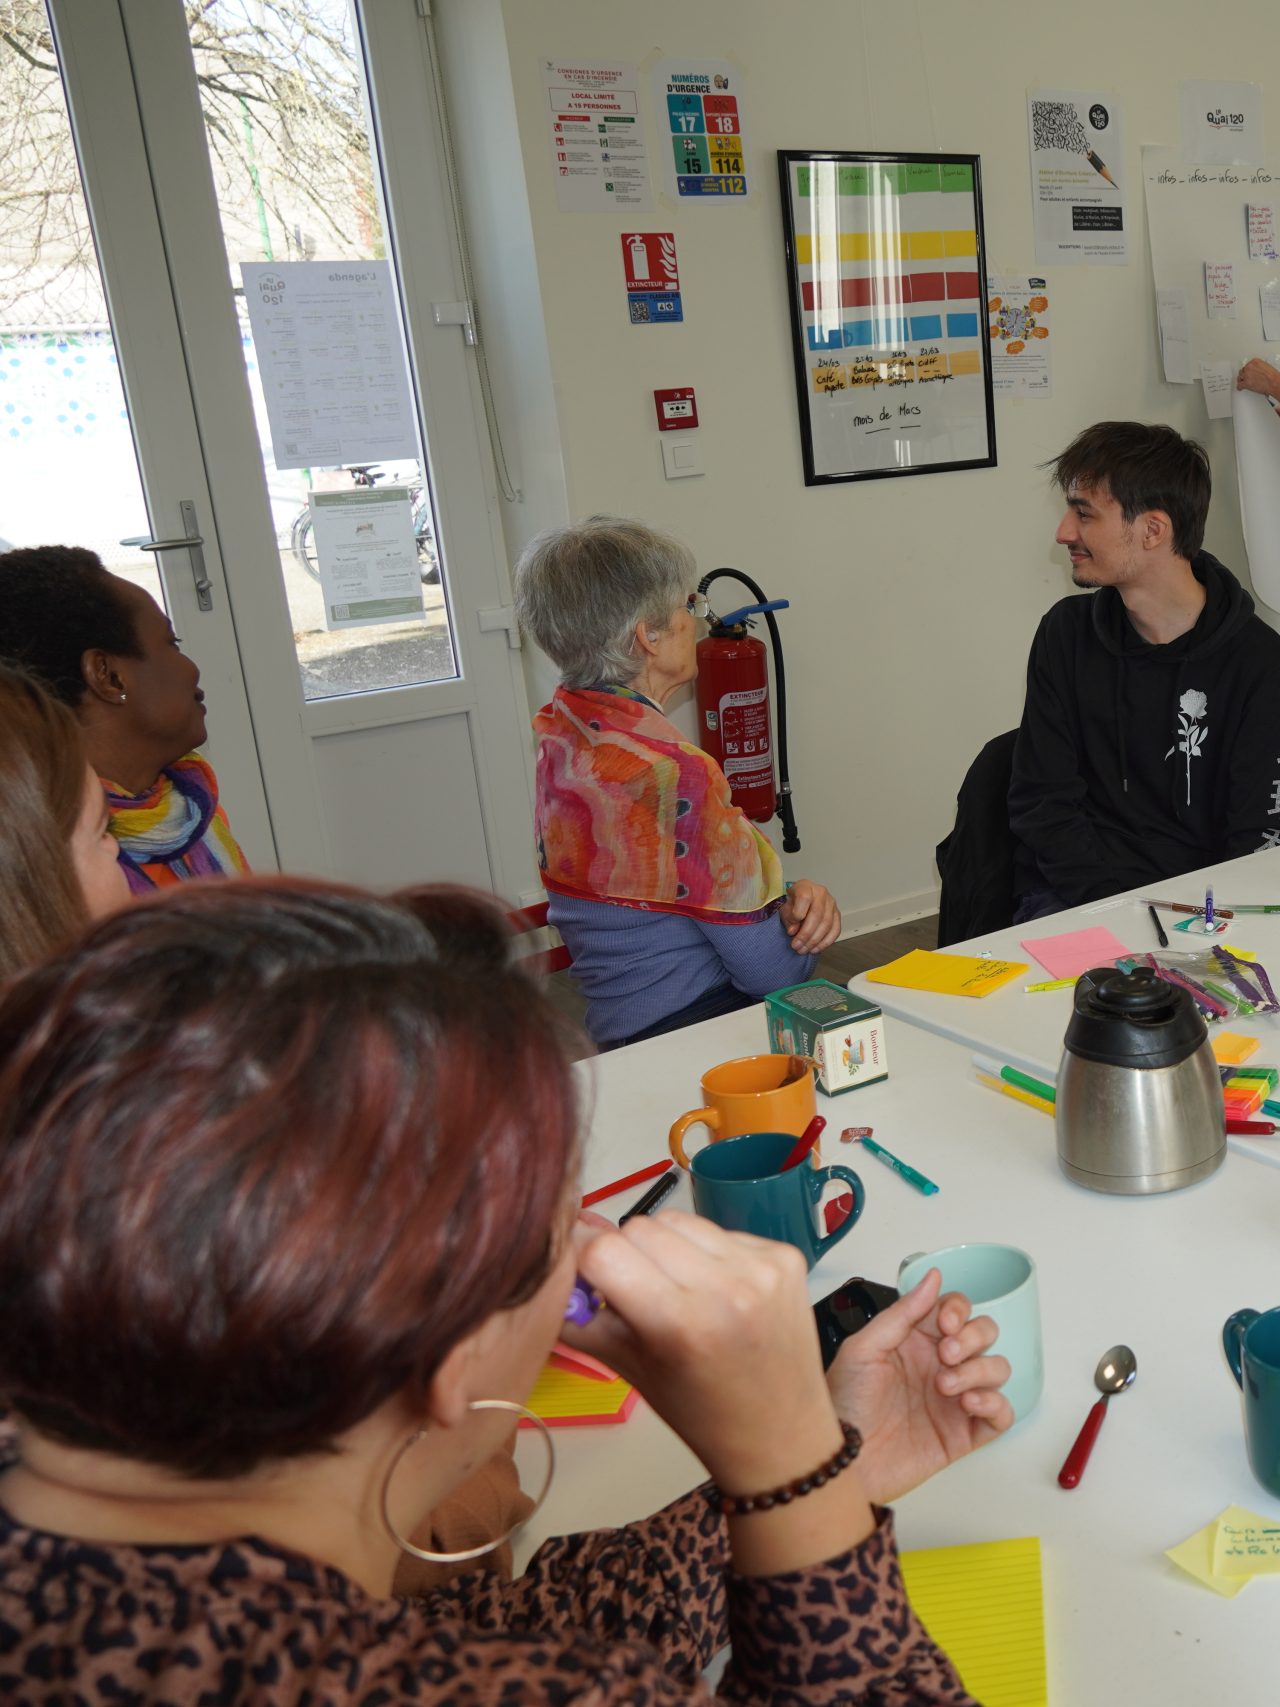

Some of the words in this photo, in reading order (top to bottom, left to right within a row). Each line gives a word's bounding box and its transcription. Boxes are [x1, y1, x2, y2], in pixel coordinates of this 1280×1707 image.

[671, 74, 710, 84] NUMÉROS
[667, 84, 712, 94] D'URGENCE
[678, 117, 697, 133] 17
[715, 117, 734, 133] 18
[1206, 112, 1229, 125] Quai
[1229, 113, 1244, 124] 120
[684, 158, 702, 174] 15
[716, 158, 742, 174] 114
[1158, 169, 1177, 184] infos
[1188, 168, 1208, 183] infos
[1218, 169, 1239, 184] infos
[1250, 167, 1272, 184] infos
[719, 177, 745, 193] 112
[816, 371, 836, 384] Café
[879, 407, 892, 420] de
[729, 689, 764, 701] EXTINCTEUR
[869, 1029, 880, 1065] Bonheur
